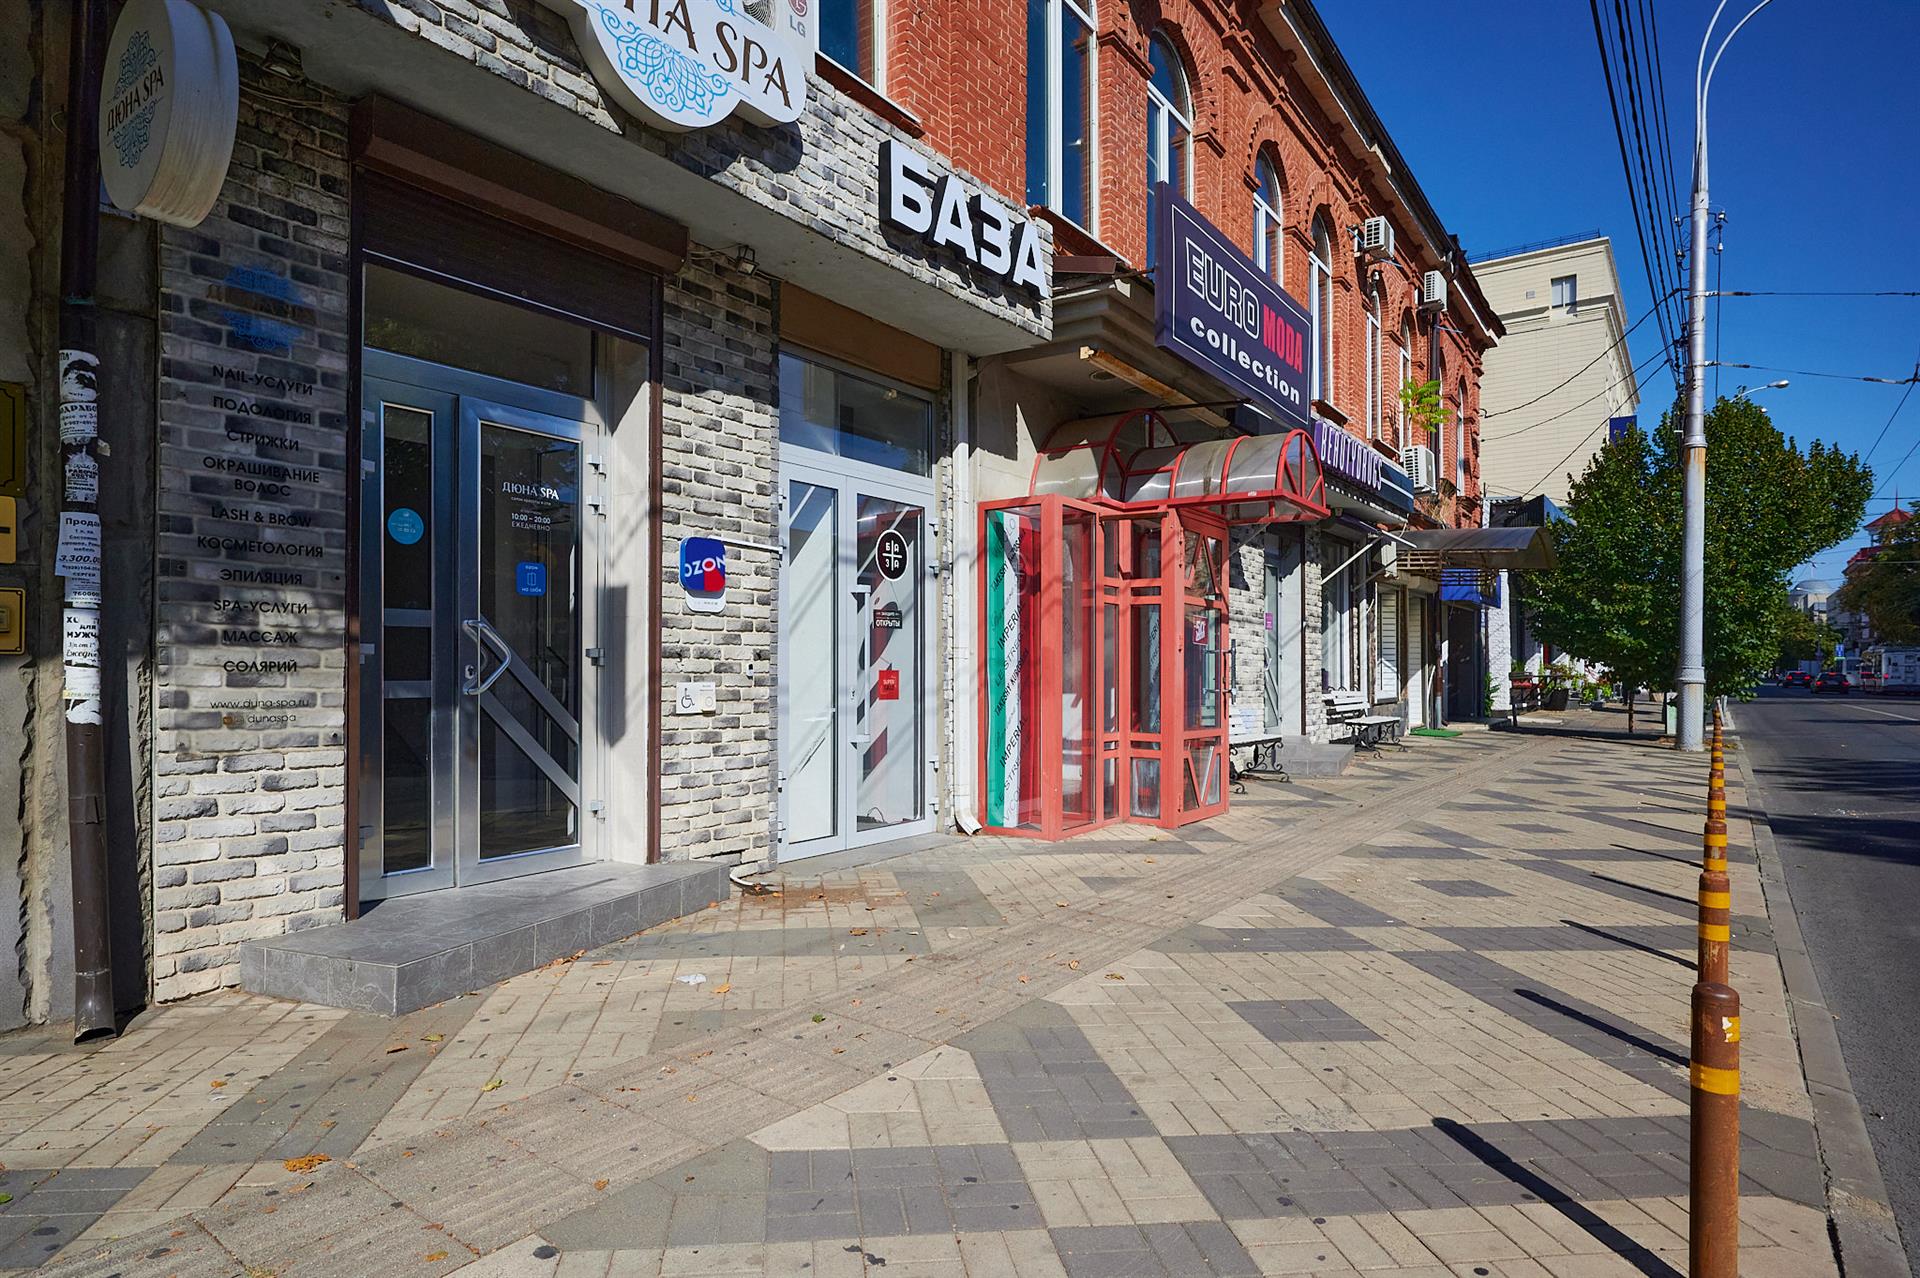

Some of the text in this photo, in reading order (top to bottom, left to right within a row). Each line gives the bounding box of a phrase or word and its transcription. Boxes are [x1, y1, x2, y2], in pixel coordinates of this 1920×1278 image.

[790, 15, 806, 38] LG
[713, 21, 793, 110] SPA
[107, 65, 165, 136] ДЮНА SPA
[880, 139, 1051, 300] БАЗА
[1186, 237, 1303, 374] EURO MODA
[1190, 316, 1300, 405] collection
[213, 365, 313, 395] NAIL-УСЛУГИ
[213, 396, 311, 424] ПОДОЛОГИЯ
[227, 430, 299, 451] СТРИЖКИ
[203, 456, 320, 483] ОКРАШИВАНИЕ
[234, 479, 291, 496] ВОЛОС
[502, 481, 560, 500] ДЮНА SPA
[211, 506, 312, 527] LASH & BROW
[197, 536, 323, 557] КОСМЕТОЛОГИЯ
[220, 569, 302, 586] ЭПИЛЯЦИЯ
[214, 600, 308, 614] SPA-УСЛУГИ
[223, 630, 298, 643] МАССАЖ
[223, 659, 297, 673] СОЛЯРИЙ
[247, 713, 297, 723] dunaspa
